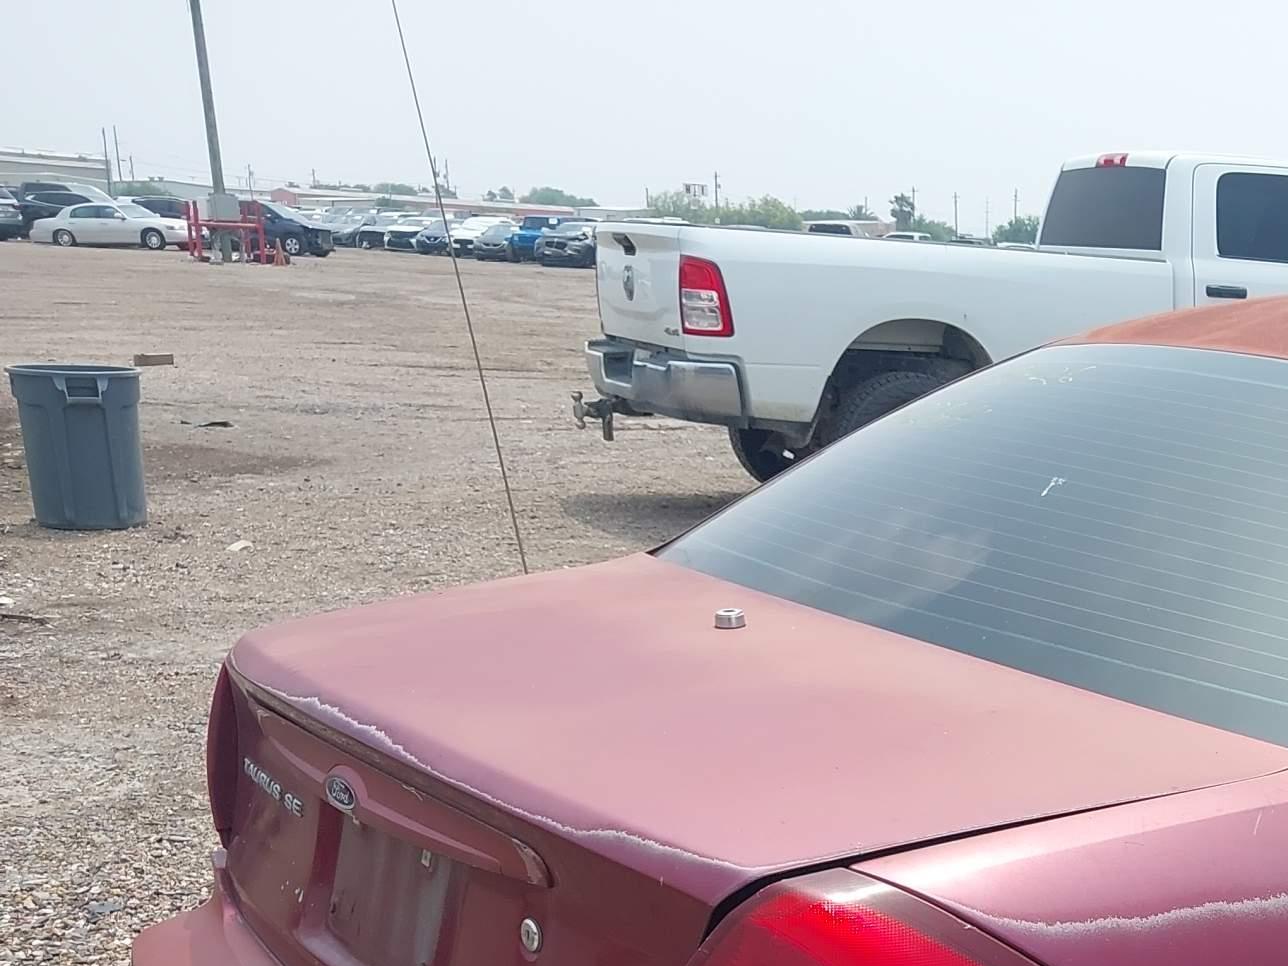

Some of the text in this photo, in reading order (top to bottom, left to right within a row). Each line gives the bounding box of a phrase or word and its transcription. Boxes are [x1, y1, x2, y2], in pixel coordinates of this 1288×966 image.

[244, 758, 303, 817] TAURUS SE
[331, 780, 350, 804] Ford
